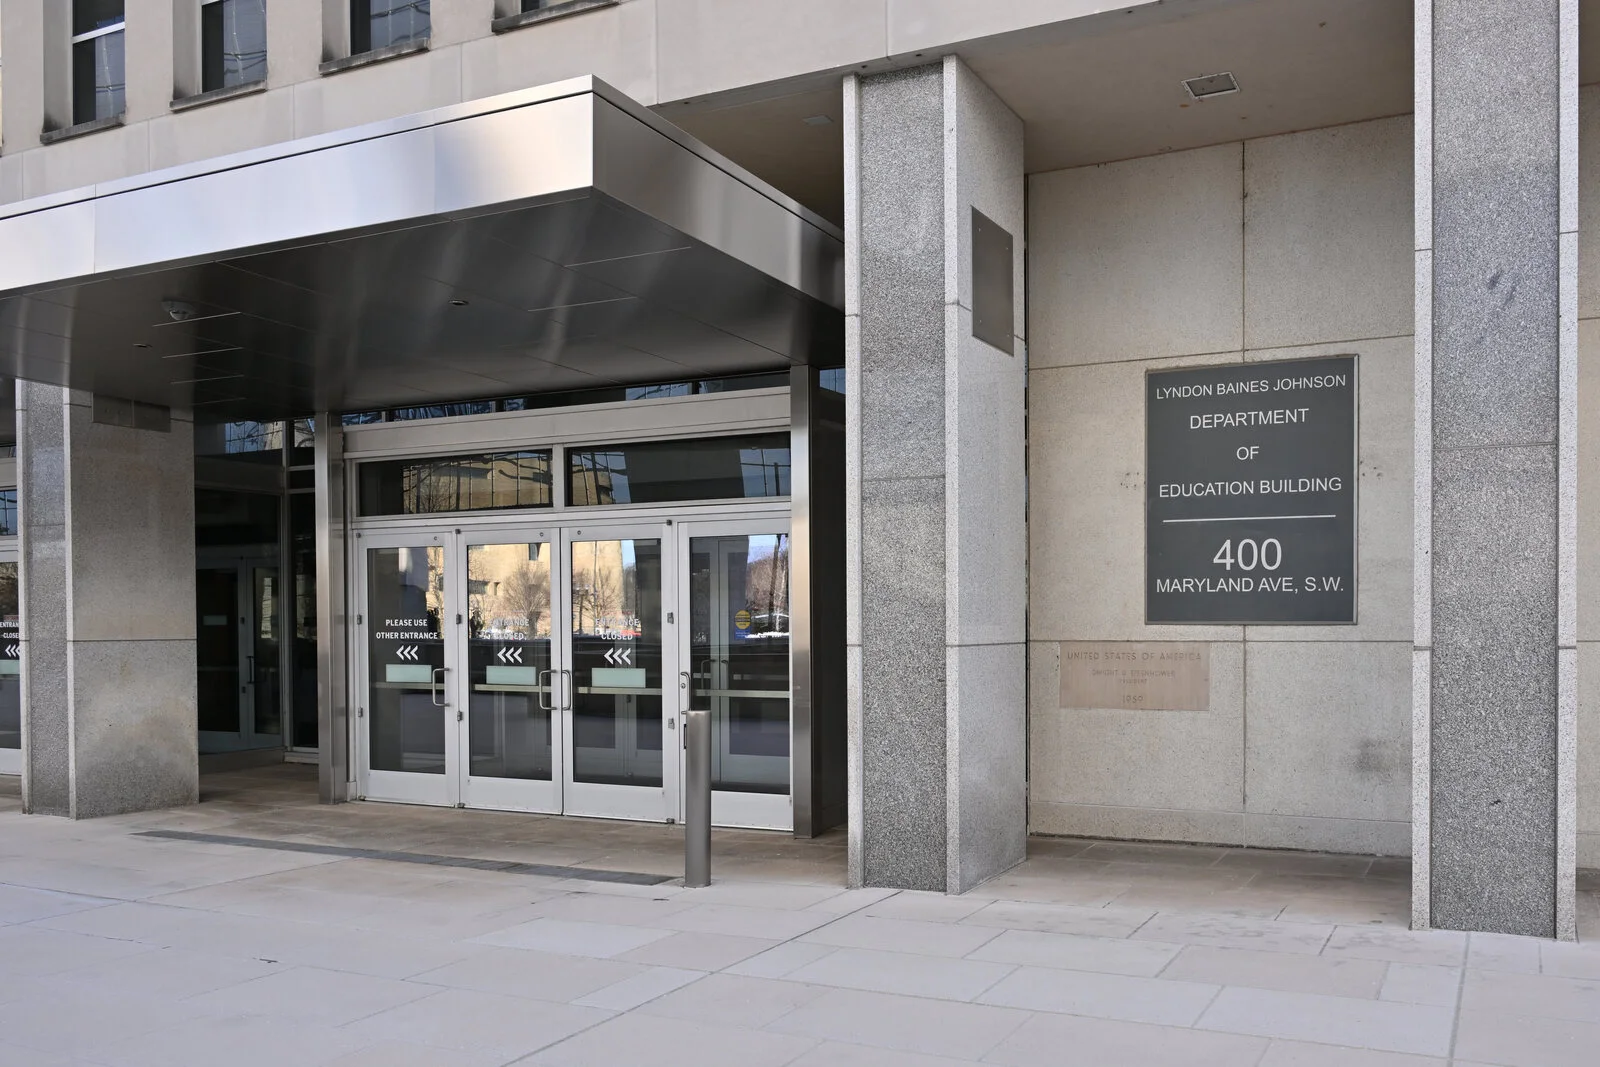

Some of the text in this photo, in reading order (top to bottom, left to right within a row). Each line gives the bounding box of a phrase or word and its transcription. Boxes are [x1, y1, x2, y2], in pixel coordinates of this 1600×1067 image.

[1156, 374, 1346, 400] LYNDON BAINES JOHNSON
[1190, 408, 1309, 430] DEPARTMENT
[1236, 446, 1260, 461] OF
[1159, 477, 1342, 498] EDUCATION BUILDING
[1213, 538, 1282, 571] 400
[1156, 576, 1344, 594] MARYLAND AVE, S.W.
[385, 618, 428, 626] PLEASE USE
[376, 631, 438, 640] OTHER ENTRANCE
[601, 631, 633, 640] CLOSED
[1067, 652, 1202, 660] UNITED STATES OF AMERICA
